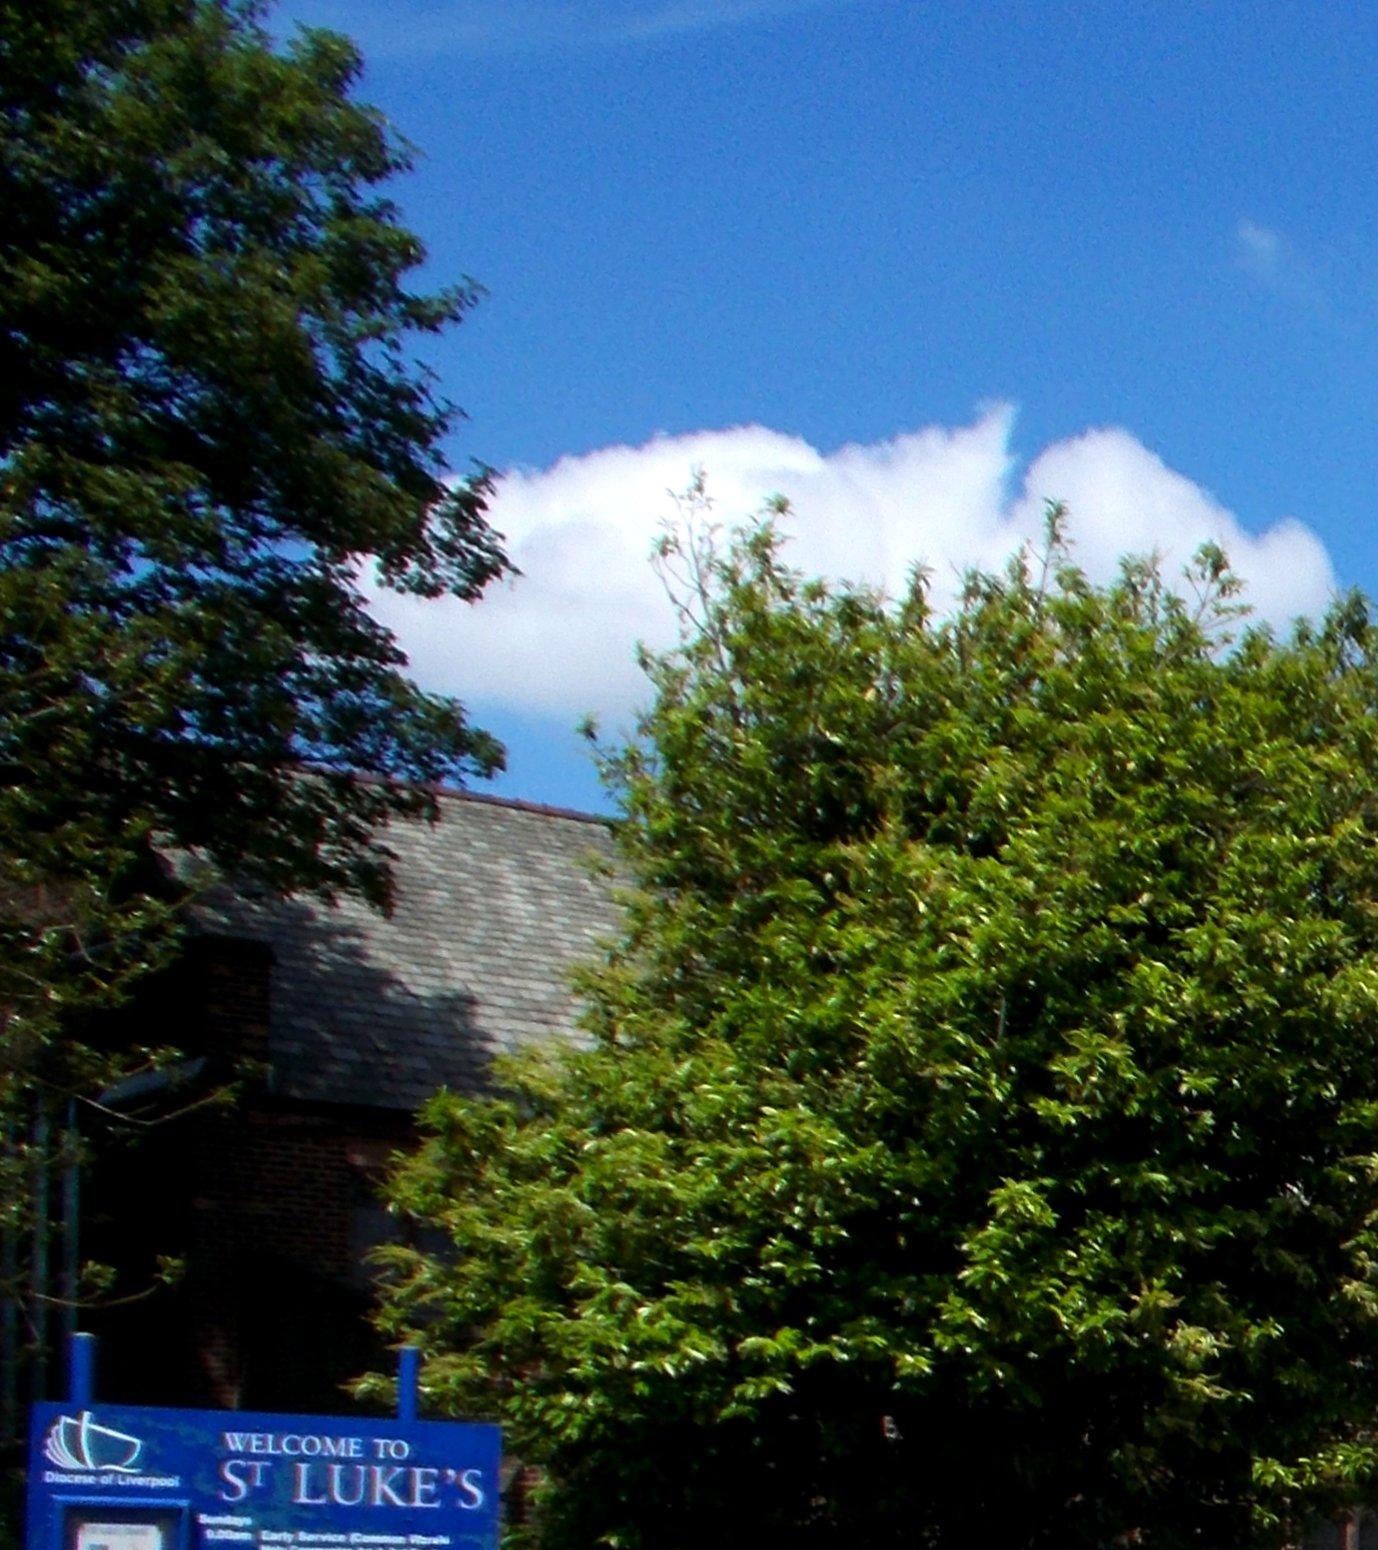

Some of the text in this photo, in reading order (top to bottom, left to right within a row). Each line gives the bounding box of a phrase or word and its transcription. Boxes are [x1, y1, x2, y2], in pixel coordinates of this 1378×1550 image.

[225, 1431, 409, 1459] WELCOME TO
[44, 1471, 180, 1489] Diocese of Liverpool
